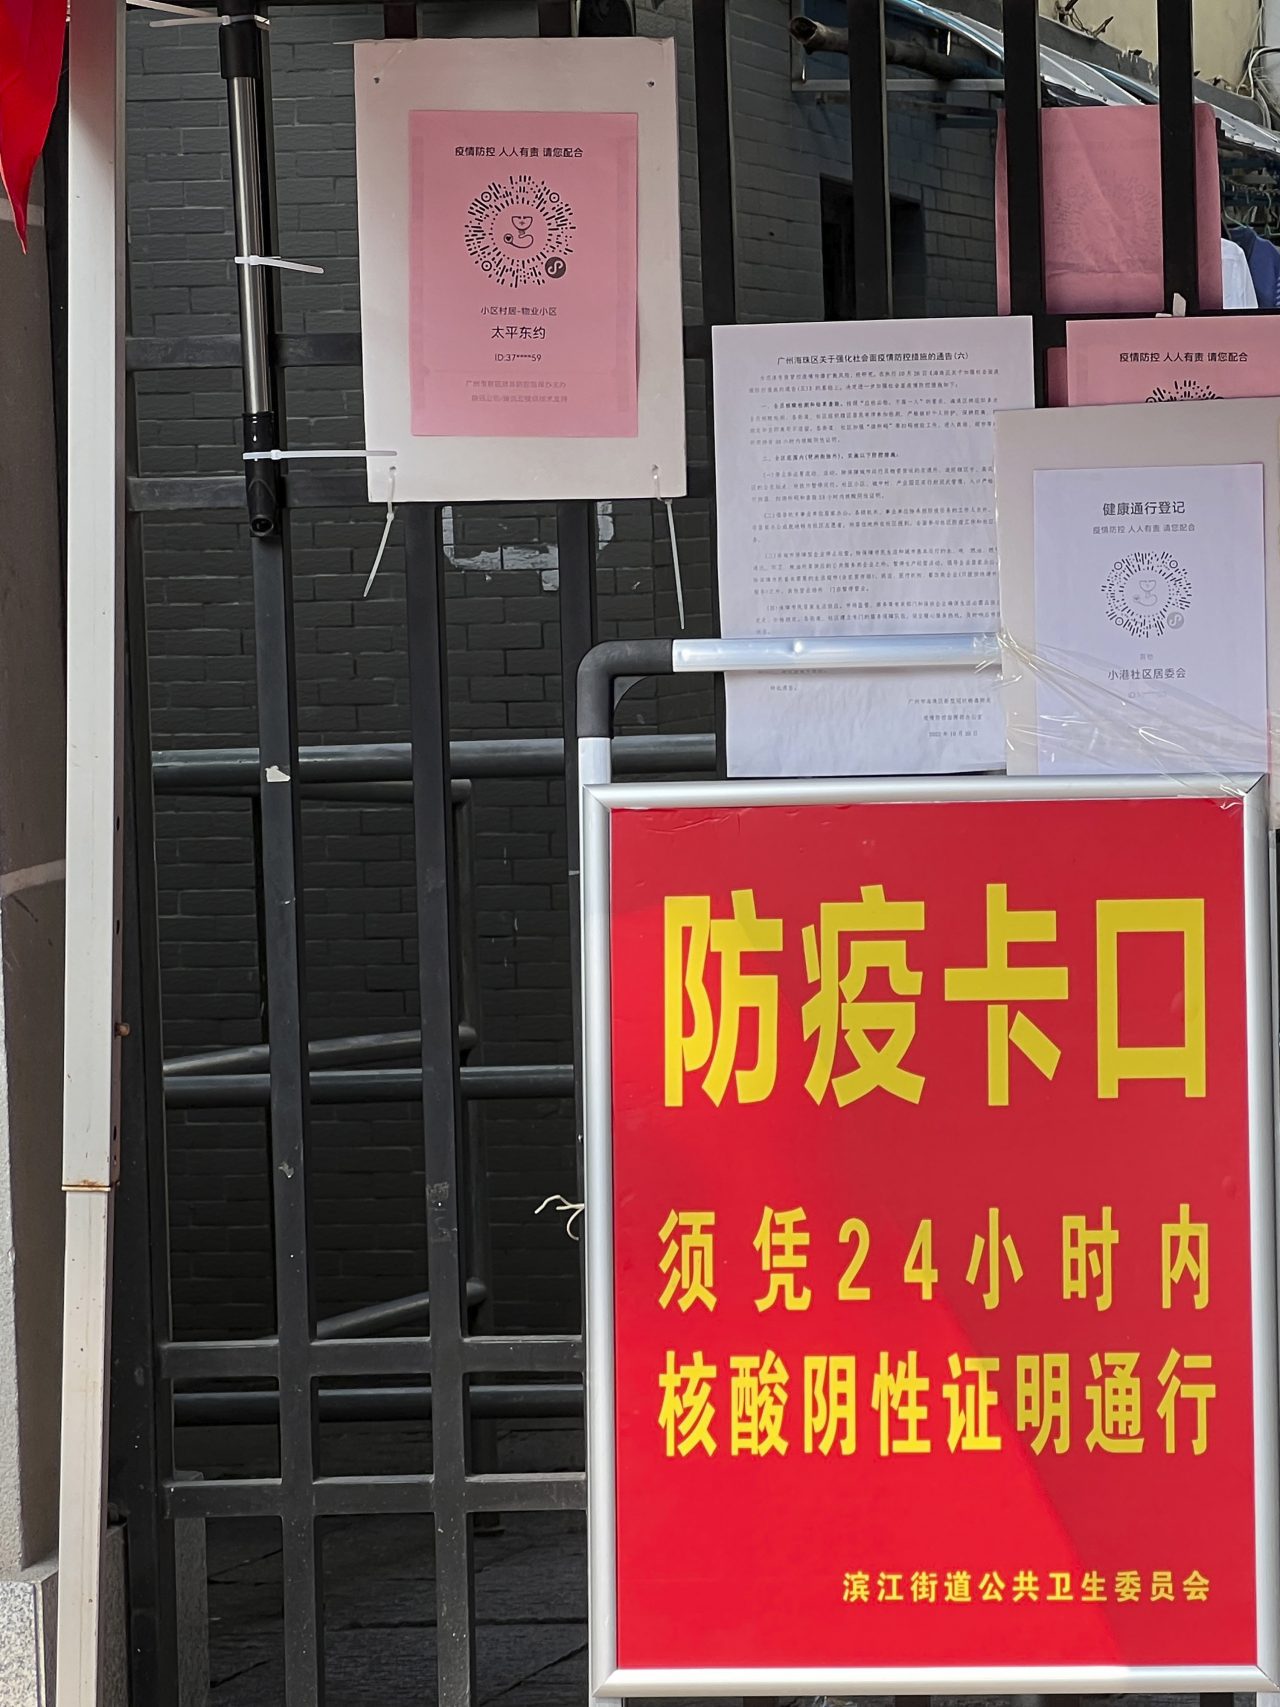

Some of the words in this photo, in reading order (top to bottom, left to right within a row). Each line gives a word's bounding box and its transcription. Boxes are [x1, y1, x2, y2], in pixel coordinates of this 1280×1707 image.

[455, 146, 496, 157] 疫情防控
[498, 147, 539, 158] 人人有责
[543, 147, 584, 158] 请您配合
[480, 306, 558, 316] 小区村居-物业小区
[491, 326, 547, 340] 太平东约
[1119, 352, 1160, 363] 疫情防控
[1163, 352, 1204, 362] 人人有责
[1207, 352, 1248, 362] 请您配合
[1102, 501, 1186, 516] 健康通行登记
[1092, 525, 1126, 535] 疫情防控
[1128, 524, 1161, 534] 人人有责
[1163, 523, 1196, 533] 请您配合
[1108, 667, 1186, 681] 小港社区居委会
[664, 884, 1206, 1107] 防疫卡口
[658, 1349, 1216, 1456] 核酸阴性证明通行
[843, 1570, 1209, 1602] 滨江街道公共卫生委员会
